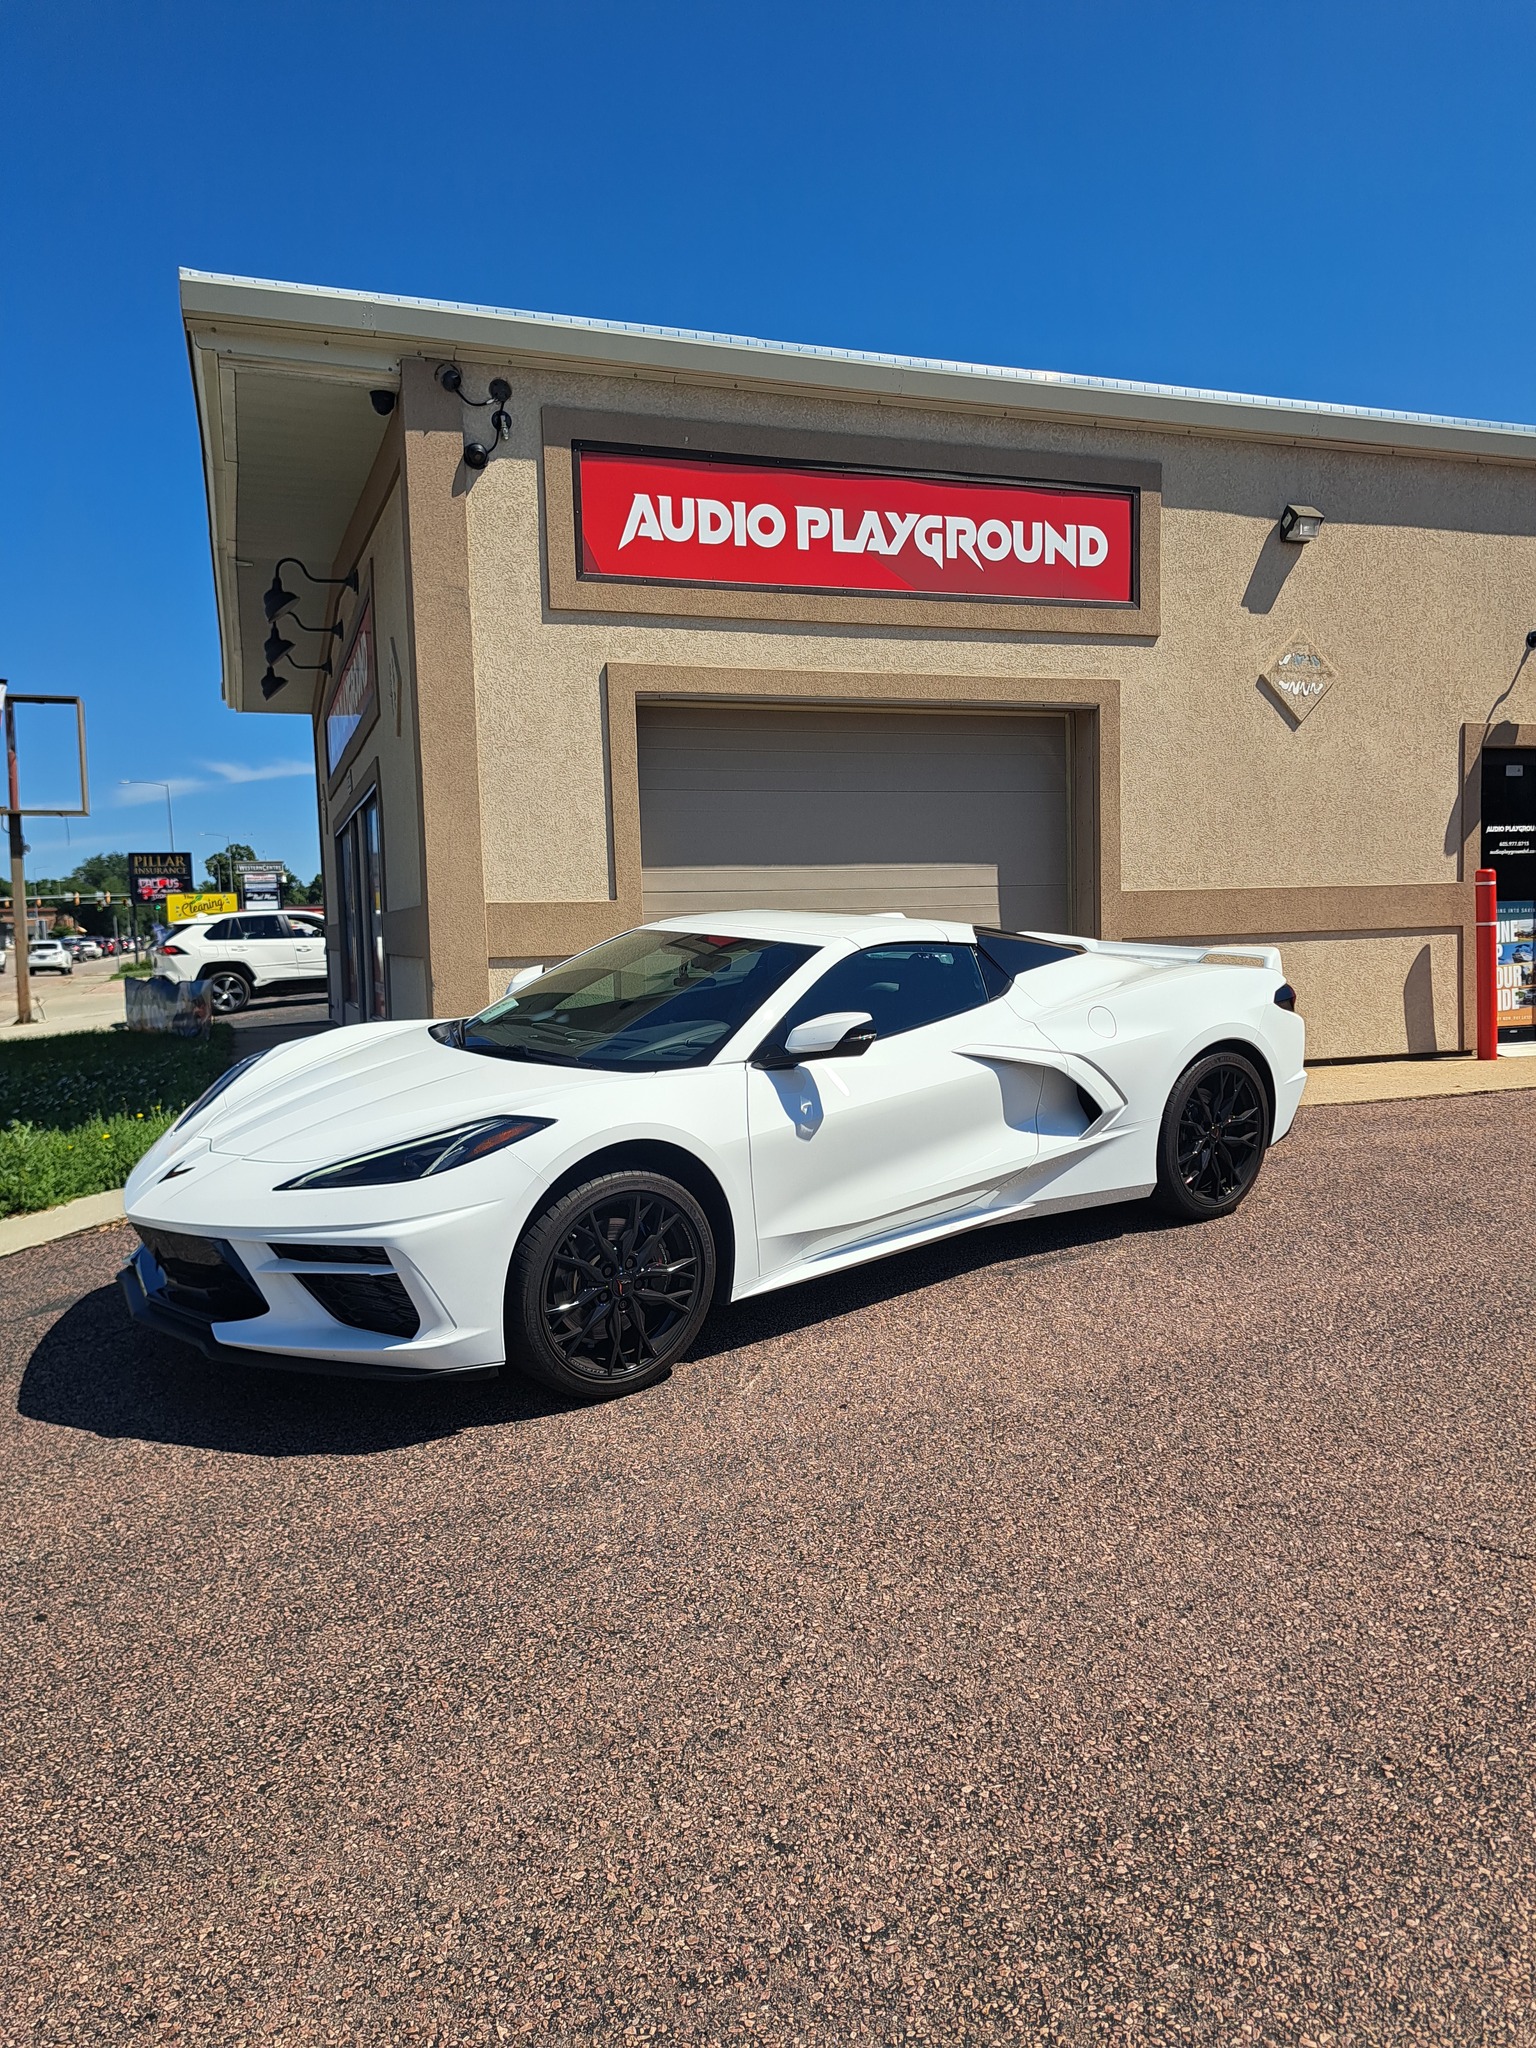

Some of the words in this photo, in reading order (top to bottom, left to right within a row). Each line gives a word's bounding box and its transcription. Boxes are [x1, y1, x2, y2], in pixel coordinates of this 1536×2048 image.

[617, 493, 786, 551] AUDIO
[794, 505, 1109, 572] PLAYGROUND
[1485, 825, 1504, 833] AUDIO
[134, 855, 186, 867] PILLAR
[181, 899, 225, 917] Cleaning
[1496, 920, 1518, 944] UNE
[1496, 965, 1522, 988] OUR
[1497, 987, 1520, 1011] IDE
